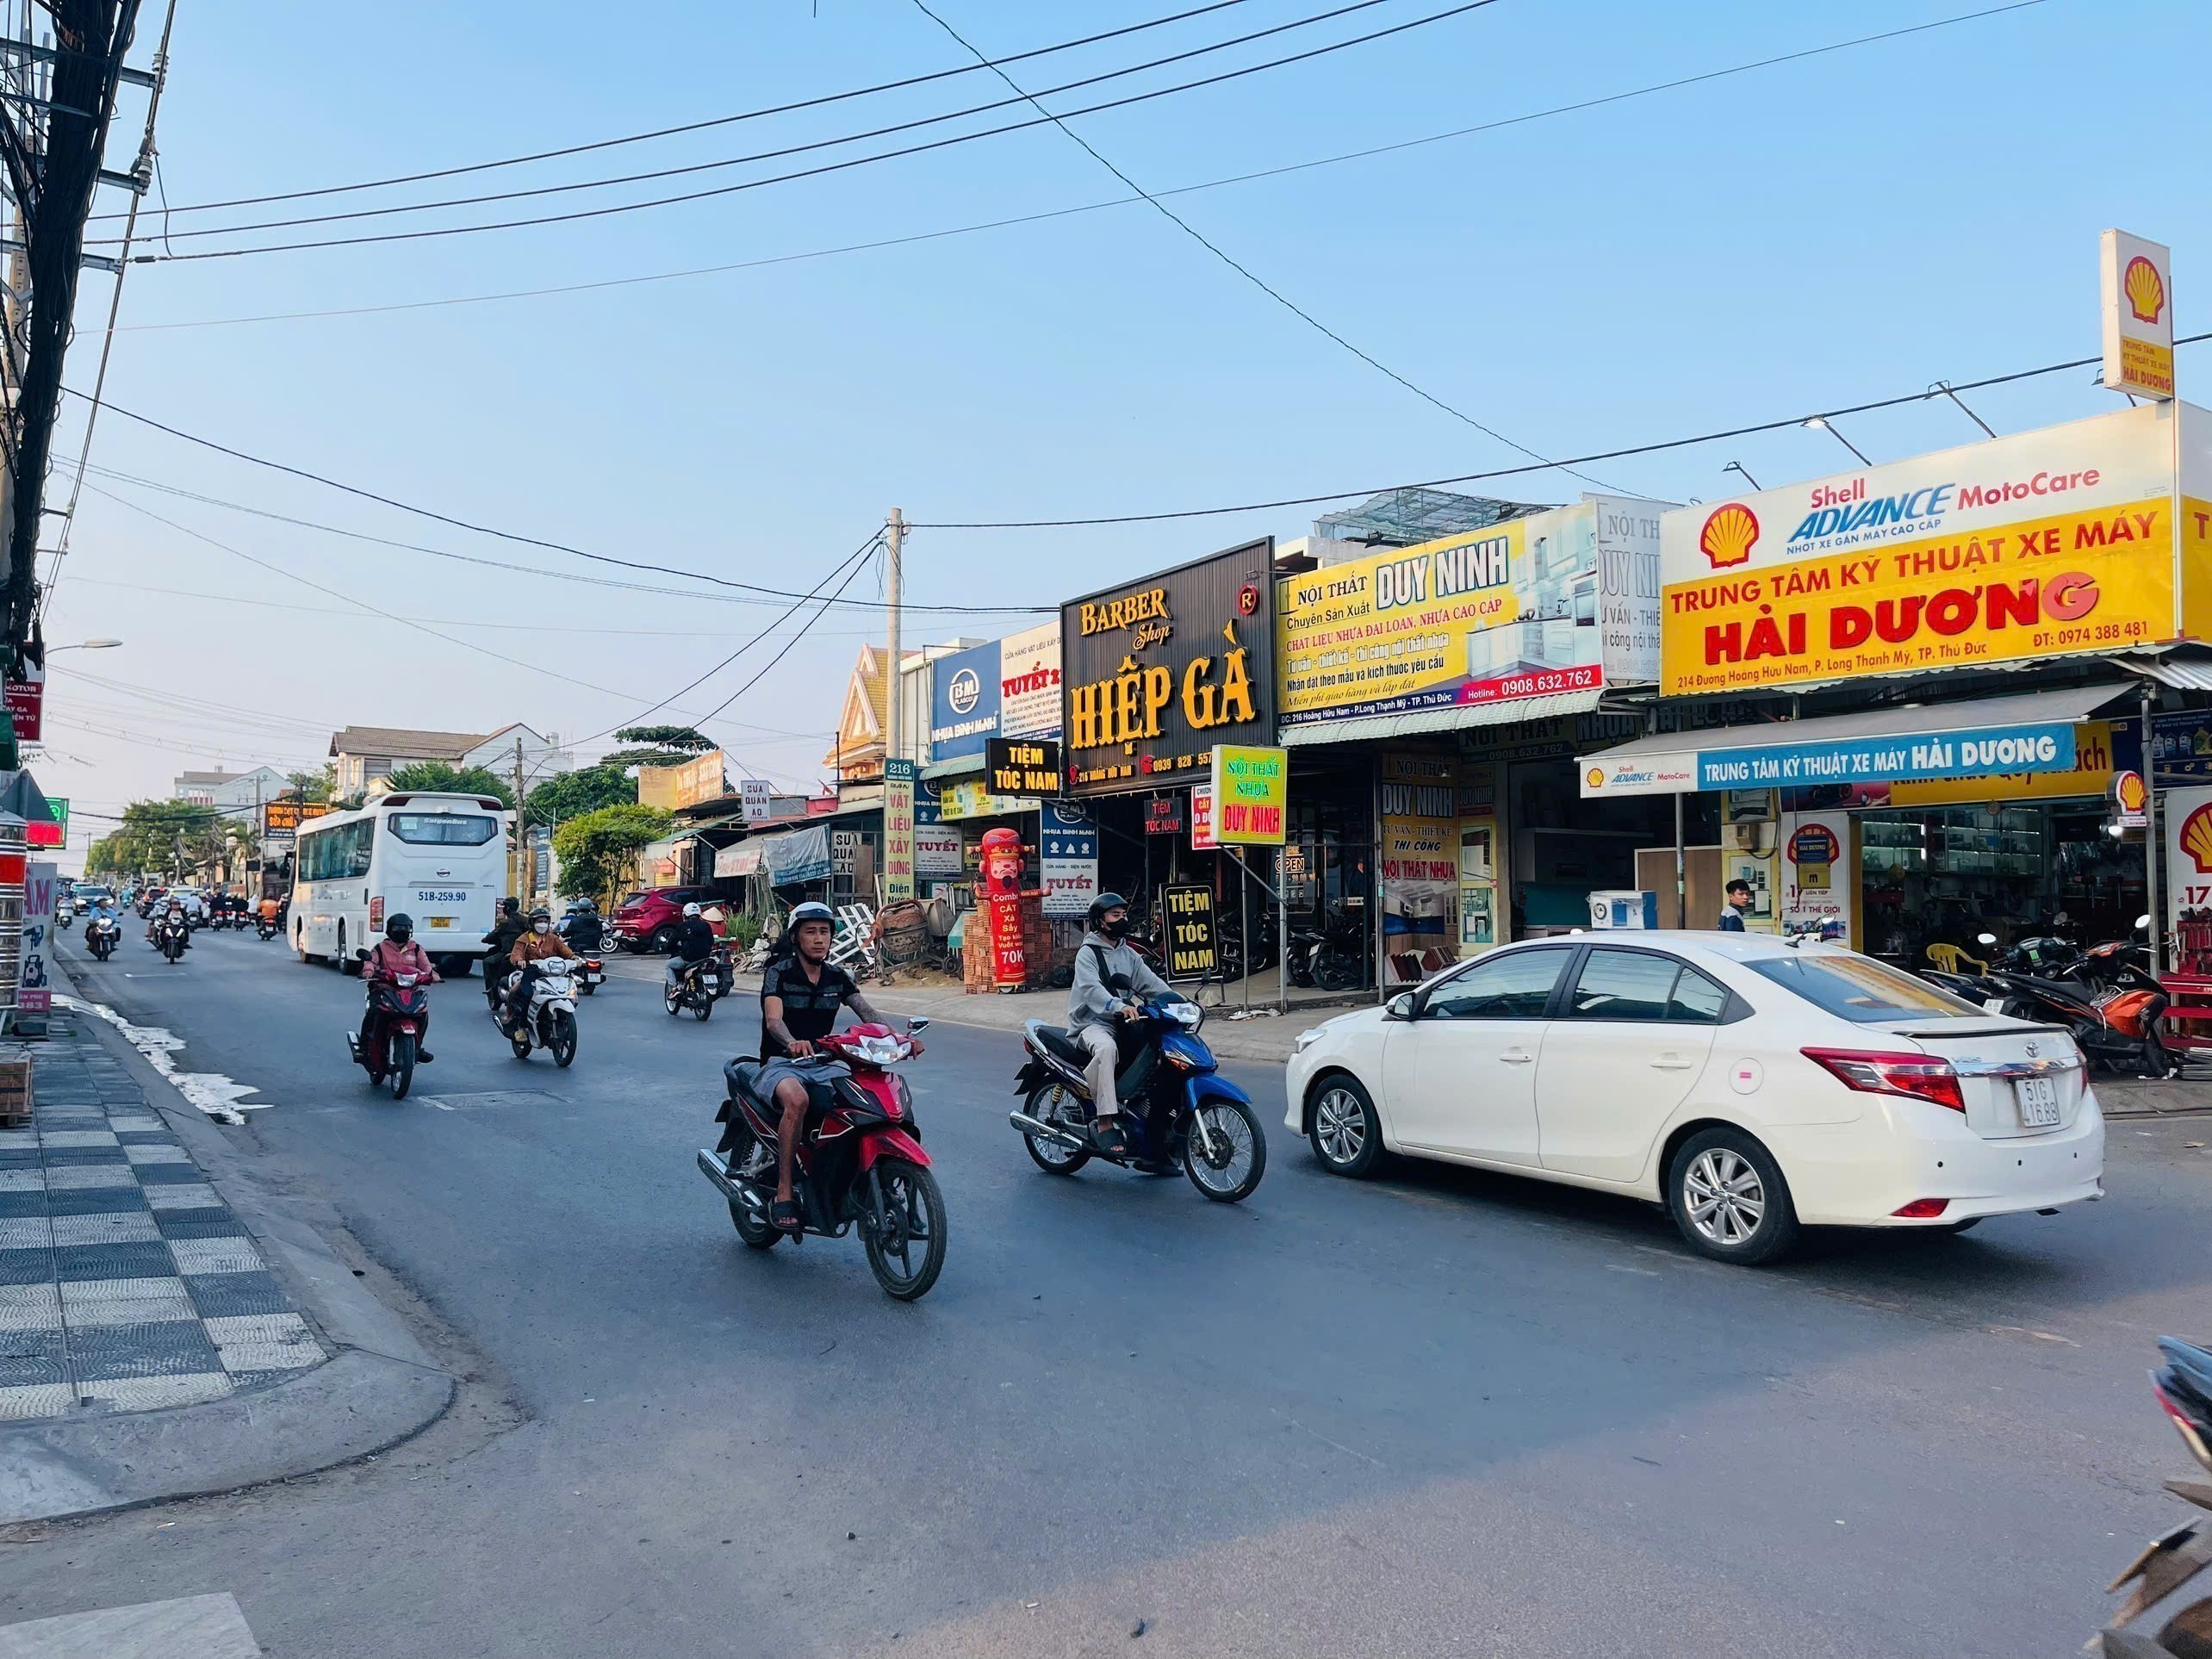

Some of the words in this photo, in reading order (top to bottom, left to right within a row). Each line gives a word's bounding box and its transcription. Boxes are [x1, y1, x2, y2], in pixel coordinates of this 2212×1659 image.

[1811, 478, 1865, 508] Shell
[1787, 482, 1955, 543] ADVANCE
[1958, 469, 2100, 510] MotoCare
[1608, 511, 1637, 543] NỘI
[1819, 540, 1831, 549] XE
[1891, 524, 1914, 536] CAO
[1298, 584, 1322, 606] NỘI
[1327, 569, 1367, 599] THẤT
[1376, 554, 1430, 611] DUY
[1436, 535, 1509, 598] NINH
[1671, 580, 1762, 613] TRUNG
[1771, 568, 1830, 598] TÂM
[1841, 554, 1881, 587] KỸ
[1894, 536, 2005, 578] THUẬT
[2017, 528, 2061, 559] XE
[2074, 510, 2158, 550] MÁY
[1080, 587, 1171, 636] BARBER
[1241, 593, 1252, 608] R
[1610, 601, 1631, 624] VẤN
[1287, 612, 1322, 630] Chuyên
[1346, 600, 1370, 616] Xuất
[1336, 626, 1364, 643] NHỰA
[1420, 609, 1451, 627] NHỰA
[1453, 604, 1476, 619] CAO
[1705, 603, 1806, 665] HẢI
[1830, 571, 2099, 650] DƯƠNG
[1134, 623, 1171, 649] Shop
[1610, 631, 1631, 651] công
[1633, 631, 1646, 651] nội
[2034, 631, 2054, 647] ĐT:
[2059, 627, 2091, 644] 0974
[2095, 624, 2120, 640] 388
[2124, 620, 2147, 637] 481
[1369, 643, 1389, 660] công
[1320, 674, 1336, 687] theo
[1412, 658, 1426, 674] yêu
[1678, 676, 1693, 687] 214
[1785, 663, 1811, 675] Nam,
[1815, 660, 1824, 671] P.
[1828, 658, 1852, 672] Long
[1856, 651, 1890, 668] Thạnh
[1918, 647, 1936, 660] TP.
[954, 680, 975, 699] BM
[1002, 661, 1049, 698] TUYẾT
[1071, 655, 1172, 755] HIỆP
[1182, 619, 1256, 729] GÀ
[1468, 687, 1497, 699] Hotline:
[1501, 669, 1593, 696] 0908.632.762
[1292, 713, 1302, 722] 216
[1336, 707, 1350, 716] Nam
[1354, 704, 1375, 714] P.Long
[1411, 697, 1422, 706] TP.
[1010, 743, 1043, 768] TIỆM
[1153, 758, 1171, 772] 0939
[1177, 755, 1192, 768] 828
[1198, 752, 1212, 765] 557
[1488, 744, 1564, 760] 0908.632.762
[1705, 764, 1749, 782] TRUNG
[1752, 757, 1779, 779] TÂM
[1783, 755, 1800, 778] KỸ
[1803, 751, 1849, 779] THUẬT
[1852, 754, 1869, 774] XE
[1874, 747, 1906, 772] MÁY
[1911, 737, 1953, 769] HẢI
[1961, 736, 2057, 767] DƯƠNG
[889, 763, 910, 774] 216
[995, 764, 1021, 790] TÓC
[1025, 770, 1058, 791] NAM
[1227, 755, 1248, 780] NỘI
[1251, 756, 1280, 778] THẤT
[1396, 758, 1418, 780] NỘI
[1611, 772, 1655, 783] ADVANCE
[890, 792, 910, 811] VẬT
[1235, 780, 1270, 800] NHỰA
[1382, 783, 1413, 816] DUY
[1416, 785, 1454, 818] NINH
[888, 814, 910, 835] LIỆU
[1162, 819, 1179, 832] NAM
[1224, 803, 1248, 833] DUY
[1251, 805, 1281, 834] NINH
[889, 836, 910, 854] XÂY
[916, 839, 958, 852] TUYẾT
[1394, 840, 1410, 850] THI
[1414, 838, 1441, 852] CÔNG
[888, 858, 910, 878] DỰNG
[1382, 857, 1400, 882] NỘI
[889, 883, 910, 896] Điện
[1047, 874, 1092, 889] TUYẾT
[419, 892, 466, 902] 51B-259.90
[1169, 890, 1209, 916] TIỆM
[2185, 886, 2211, 904] 17
[1176, 921, 1208, 943] TÓC
[1002, 949, 1024, 964] 70K
[1175, 949, 1214, 970] NAM
[2025, 1081, 2047, 1101] 51G
